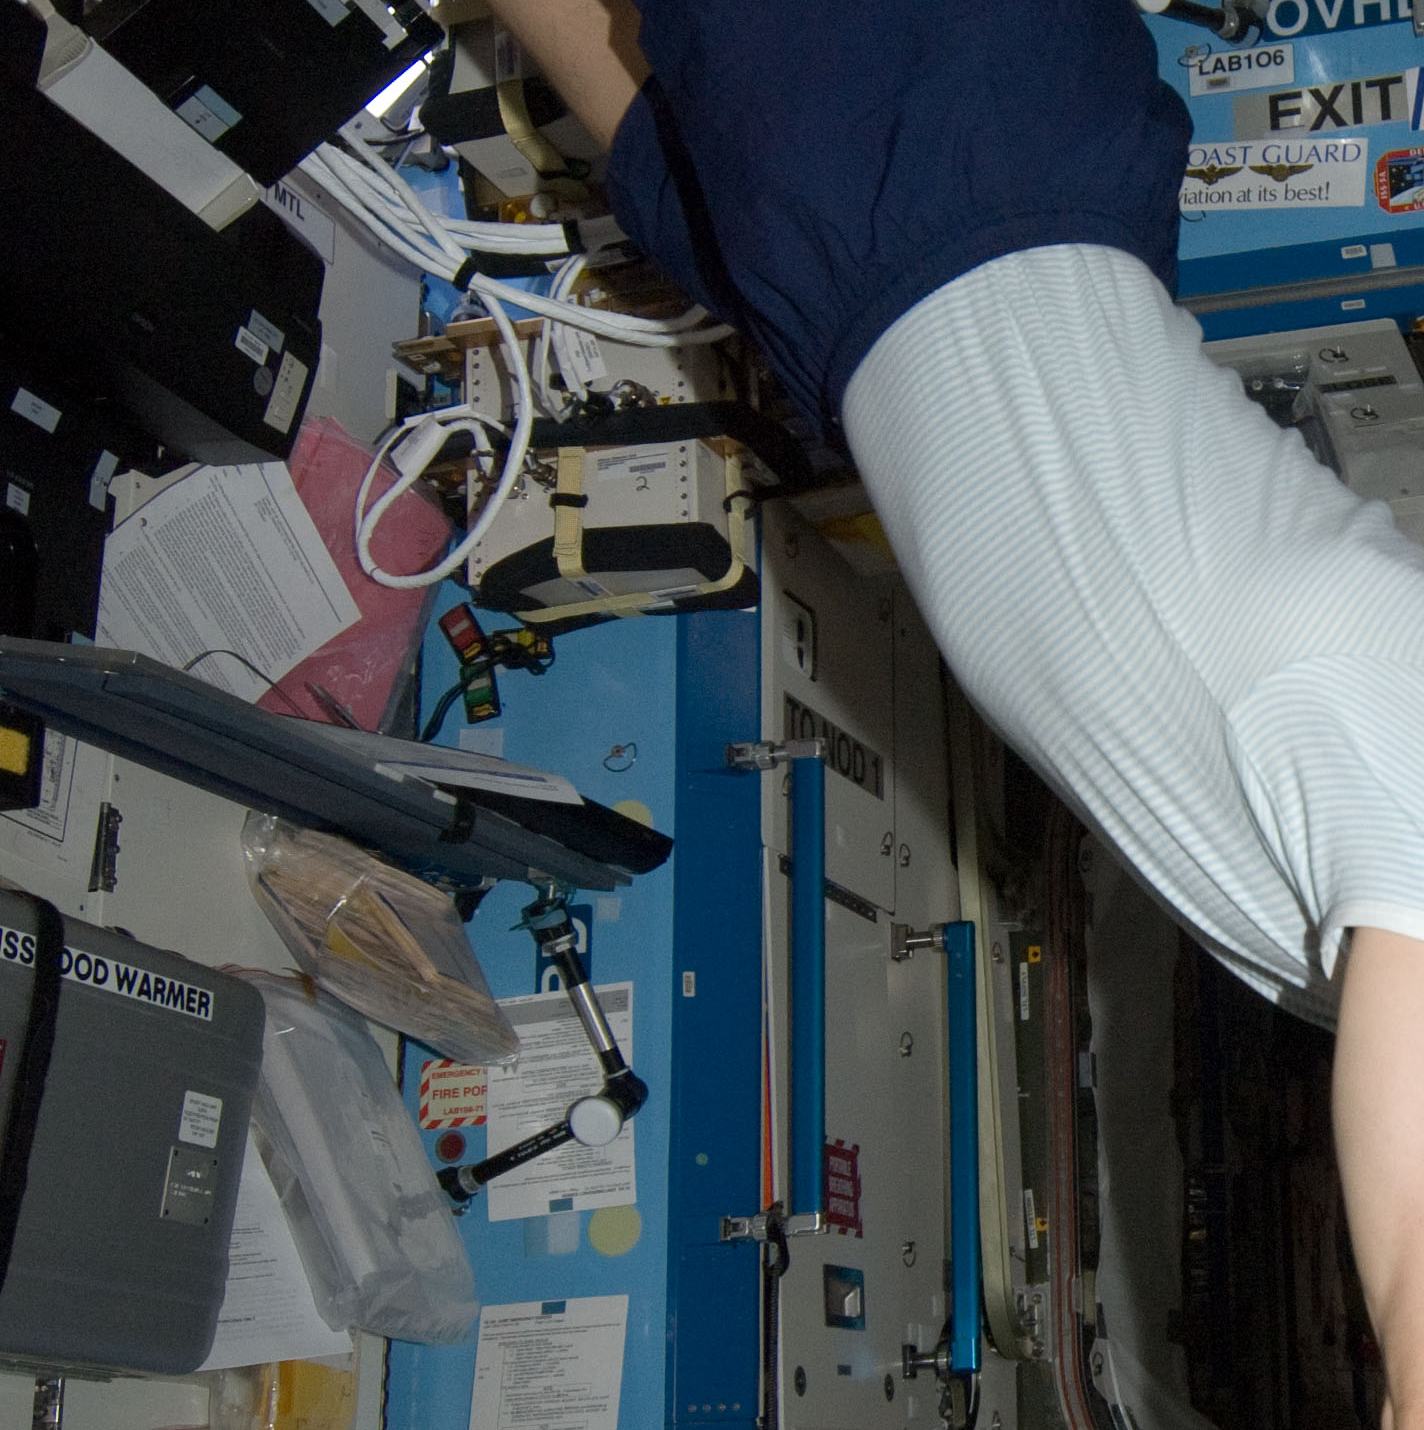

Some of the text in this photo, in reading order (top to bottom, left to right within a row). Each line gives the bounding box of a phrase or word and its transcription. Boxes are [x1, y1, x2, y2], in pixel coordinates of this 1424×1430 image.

[1268, 75, 1403, 132] EXIT
[1261, 143, 1362, 165] GUARD
[1237, 188, 1252, 203] at
[1258, 185, 1278, 202] its
[1284, 182, 1331, 202] best!
[635, 475, 650, 492] 2
[115, 964, 211, 1018] WARMER
[431, 1067, 481, 1080] EMERGENCY
[432, 1088, 459, 1100] FIRE
